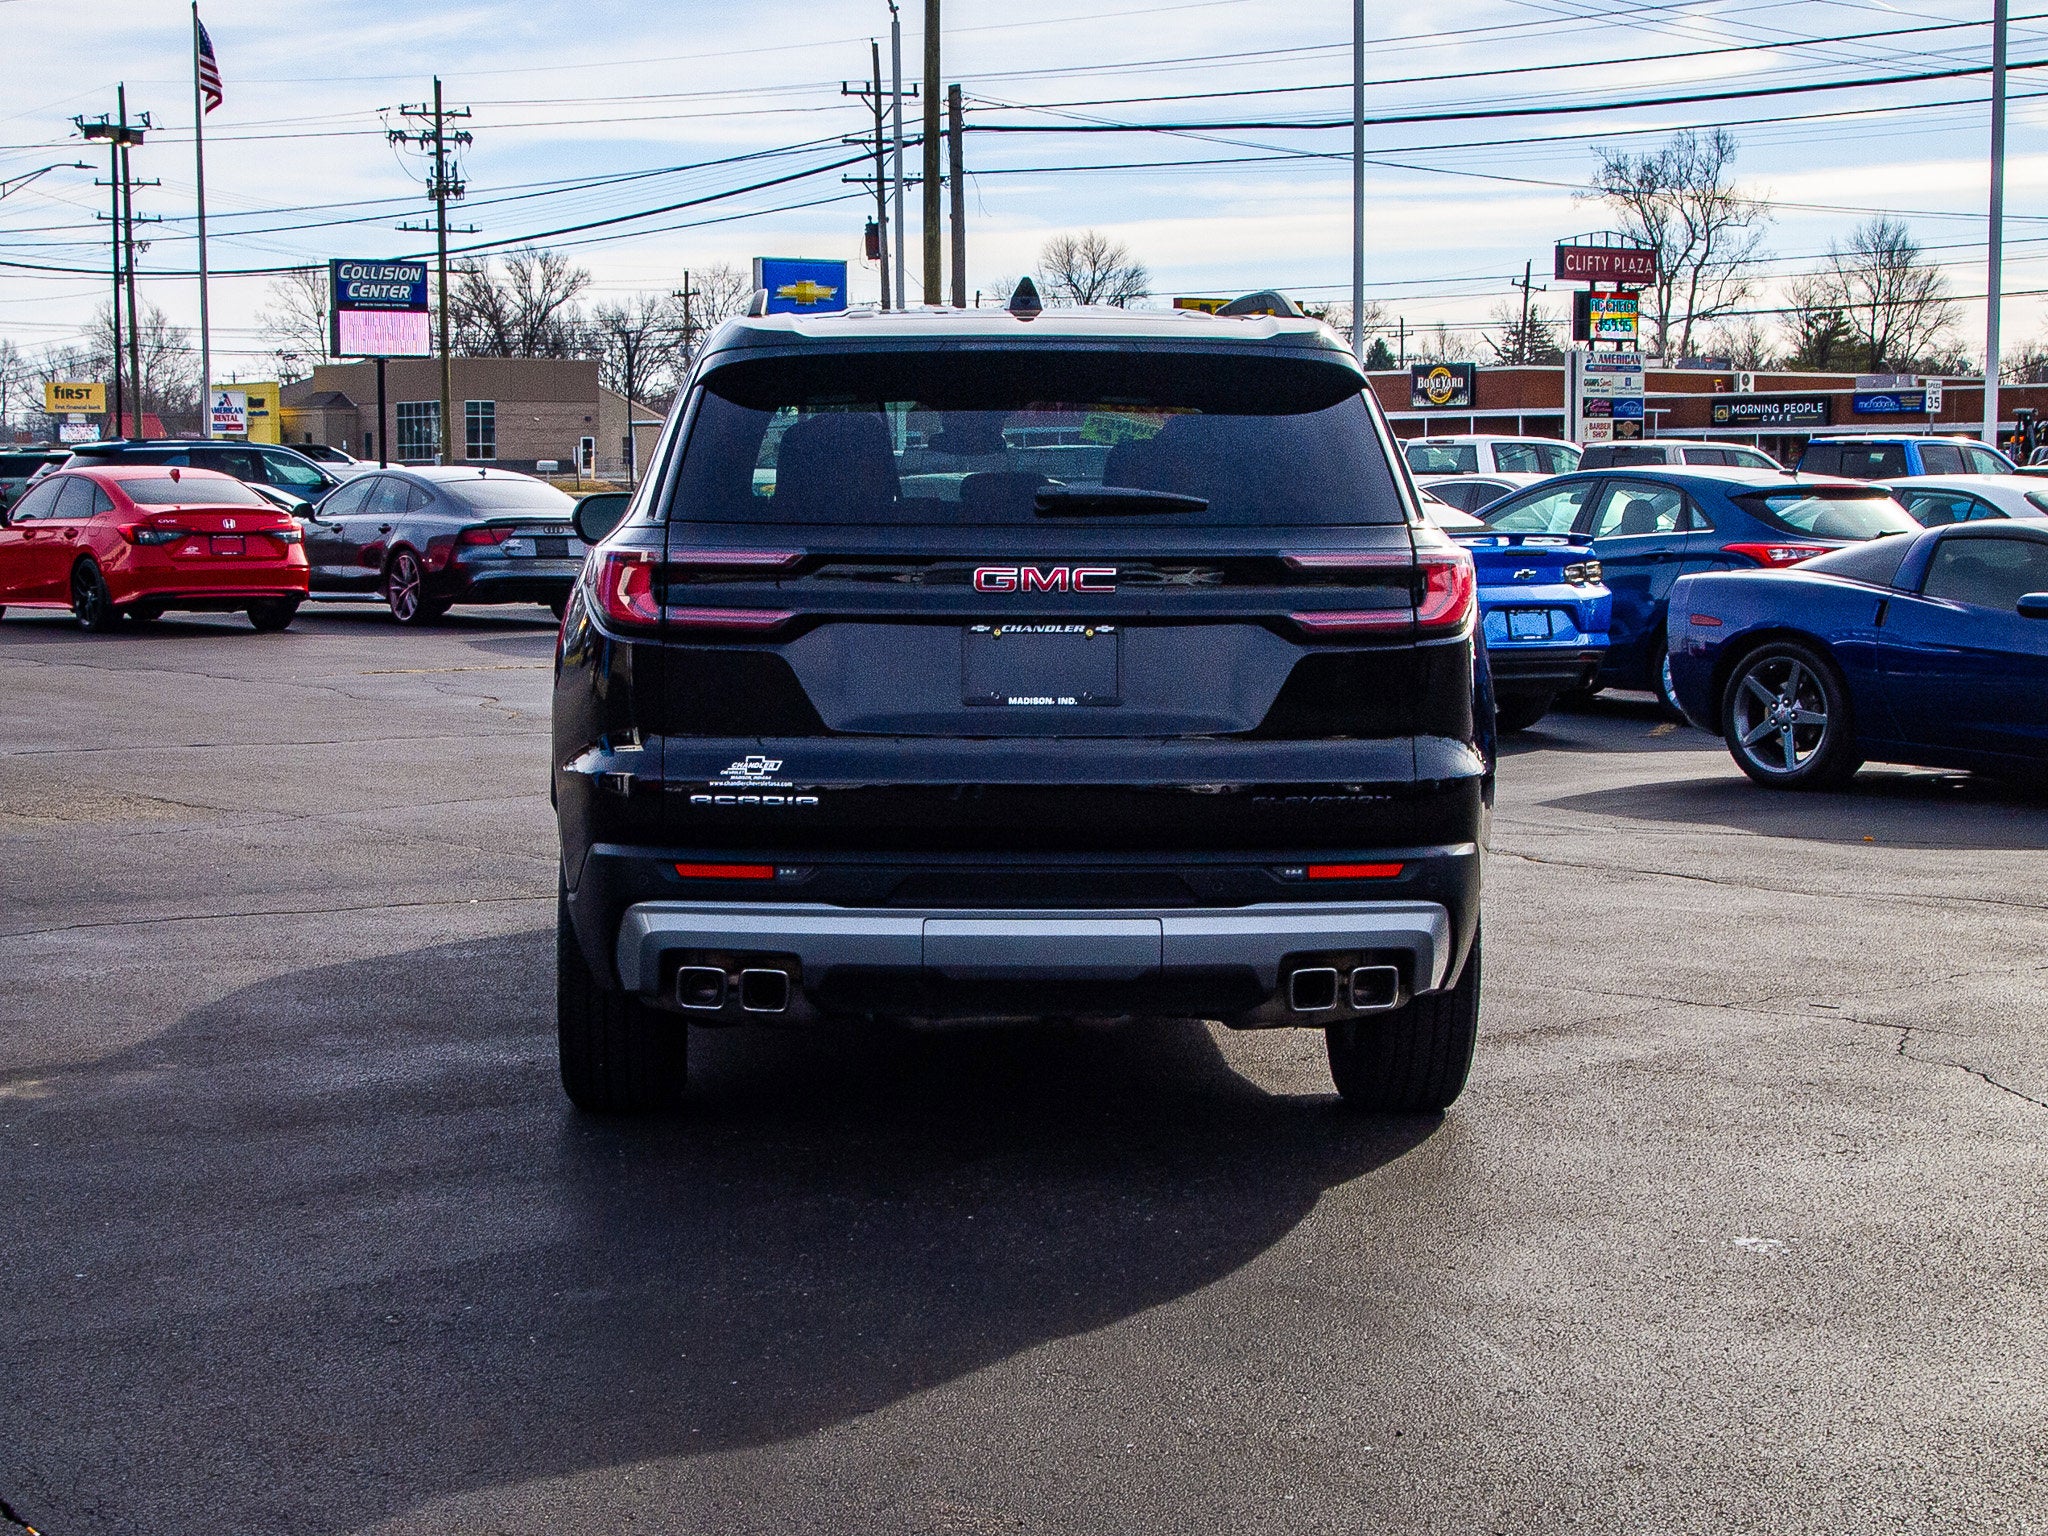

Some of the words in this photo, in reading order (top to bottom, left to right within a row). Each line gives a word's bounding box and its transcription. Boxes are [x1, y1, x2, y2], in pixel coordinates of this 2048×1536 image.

[1566, 254, 1609, 271] CLIFTY
[1614, 257, 1653, 274] PLAZA
[339, 263, 422, 281] COLLISION
[348, 282, 411, 299] CENTER
[1606, 299, 1637, 313] CHECK
[1598, 353, 1641, 365] AMERICAN
[1417, 375, 1464, 389] BONEYARD
[1731, 404, 1780, 414] MORNING
[1783, 402, 1824, 413] PEOPLE
[1927, 396, 1940, 409] 35
[1589, 422, 1611, 430] BARBER
[1592, 430, 1608, 438] SHOP
[973, 567, 1116, 592] GMC
[1001, 624, 1086, 633] CHANDLER
[1057, 697, 1078, 705] IND.
[731, 761, 775, 769] CHANDLER
[690, 795, 819, 805] ACADIA
